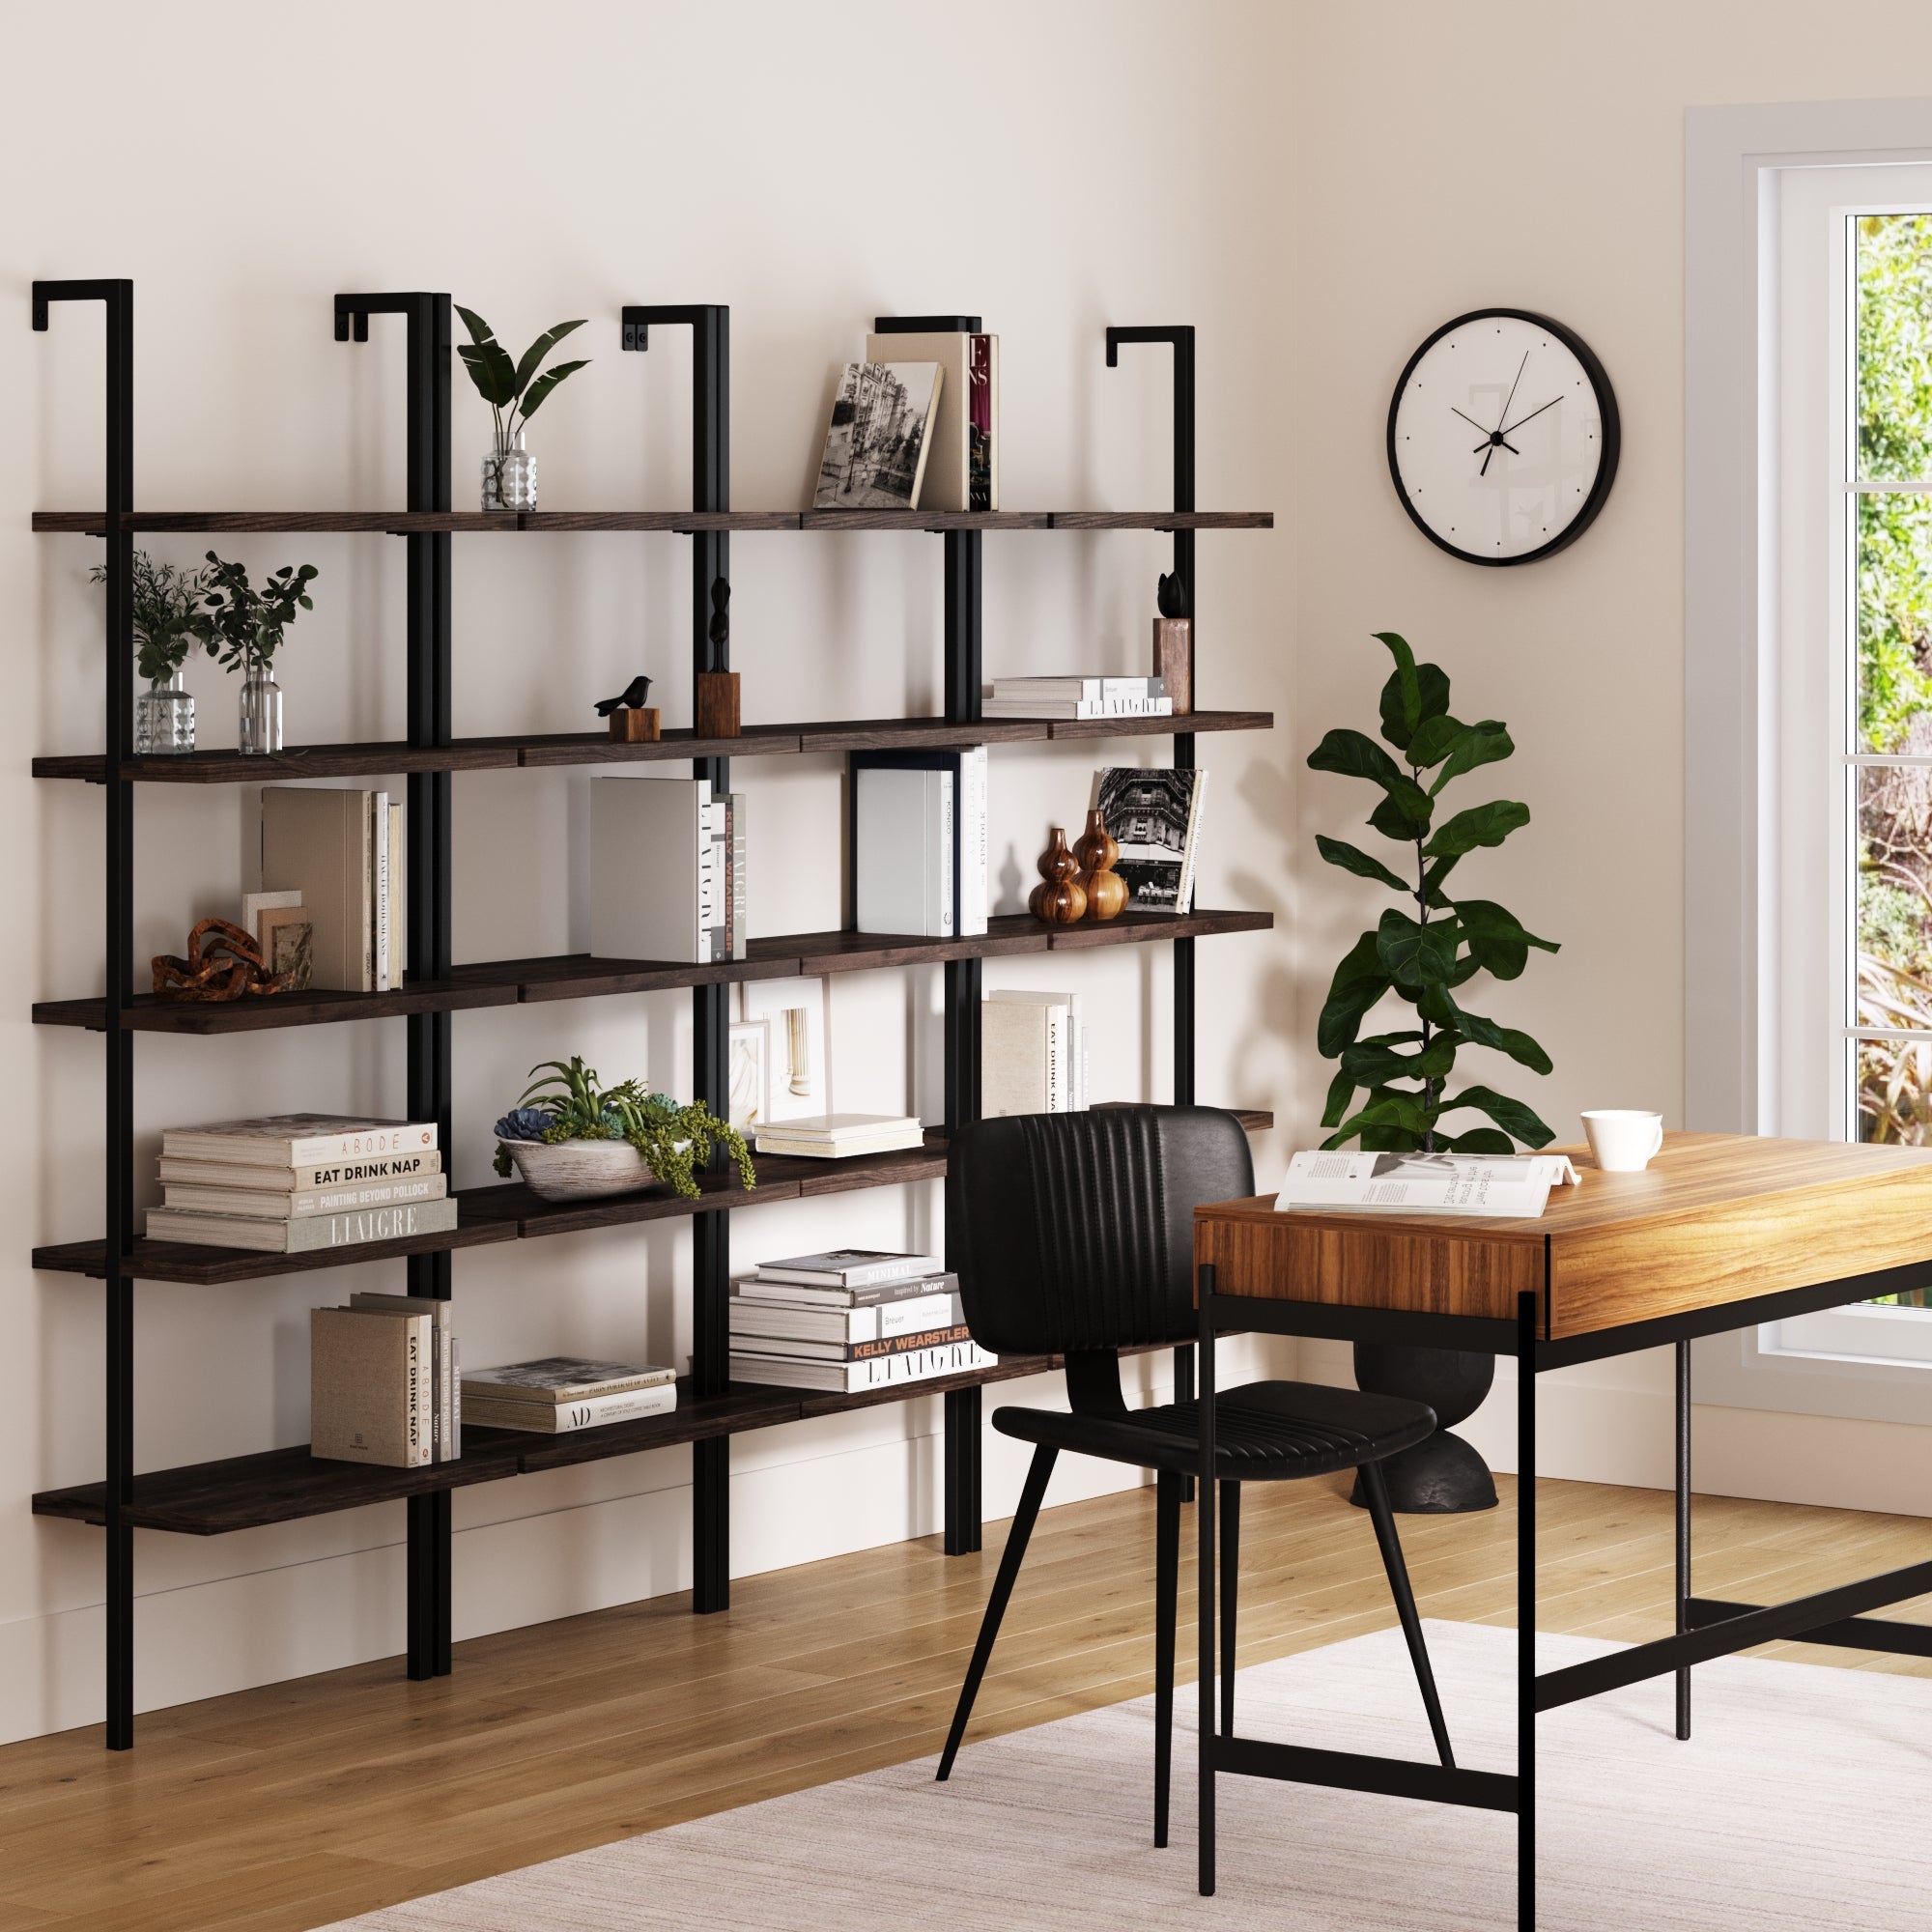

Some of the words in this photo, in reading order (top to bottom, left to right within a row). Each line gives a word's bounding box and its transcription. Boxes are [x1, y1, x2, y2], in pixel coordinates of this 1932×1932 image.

[341, 1133, 400, 1154] ABODE
[314, 1169, 340, 1184] EAT
[344, 1162, 388, 1180] DRINK
[392, 1158, 421, 1175] NAP
[320, 1194, 357, 1208] PAINTING
[359, 1188, 391, 1204] BEYOND
[393, 1181, 429, 1199] POLLOCK
[331, 1207, 417, 1245] LIAIGRE
[867, 1264, 912, 1281] MINIMAL
[921, 1280, 945, 1293] Nature
[854, 1340, 893, 1359] KELLY
[895, 1325, 970, 1351] WEARSTLER
[421, 1366, 430, 1426] ABODE
[567, 1406, 590, 1429] AD
